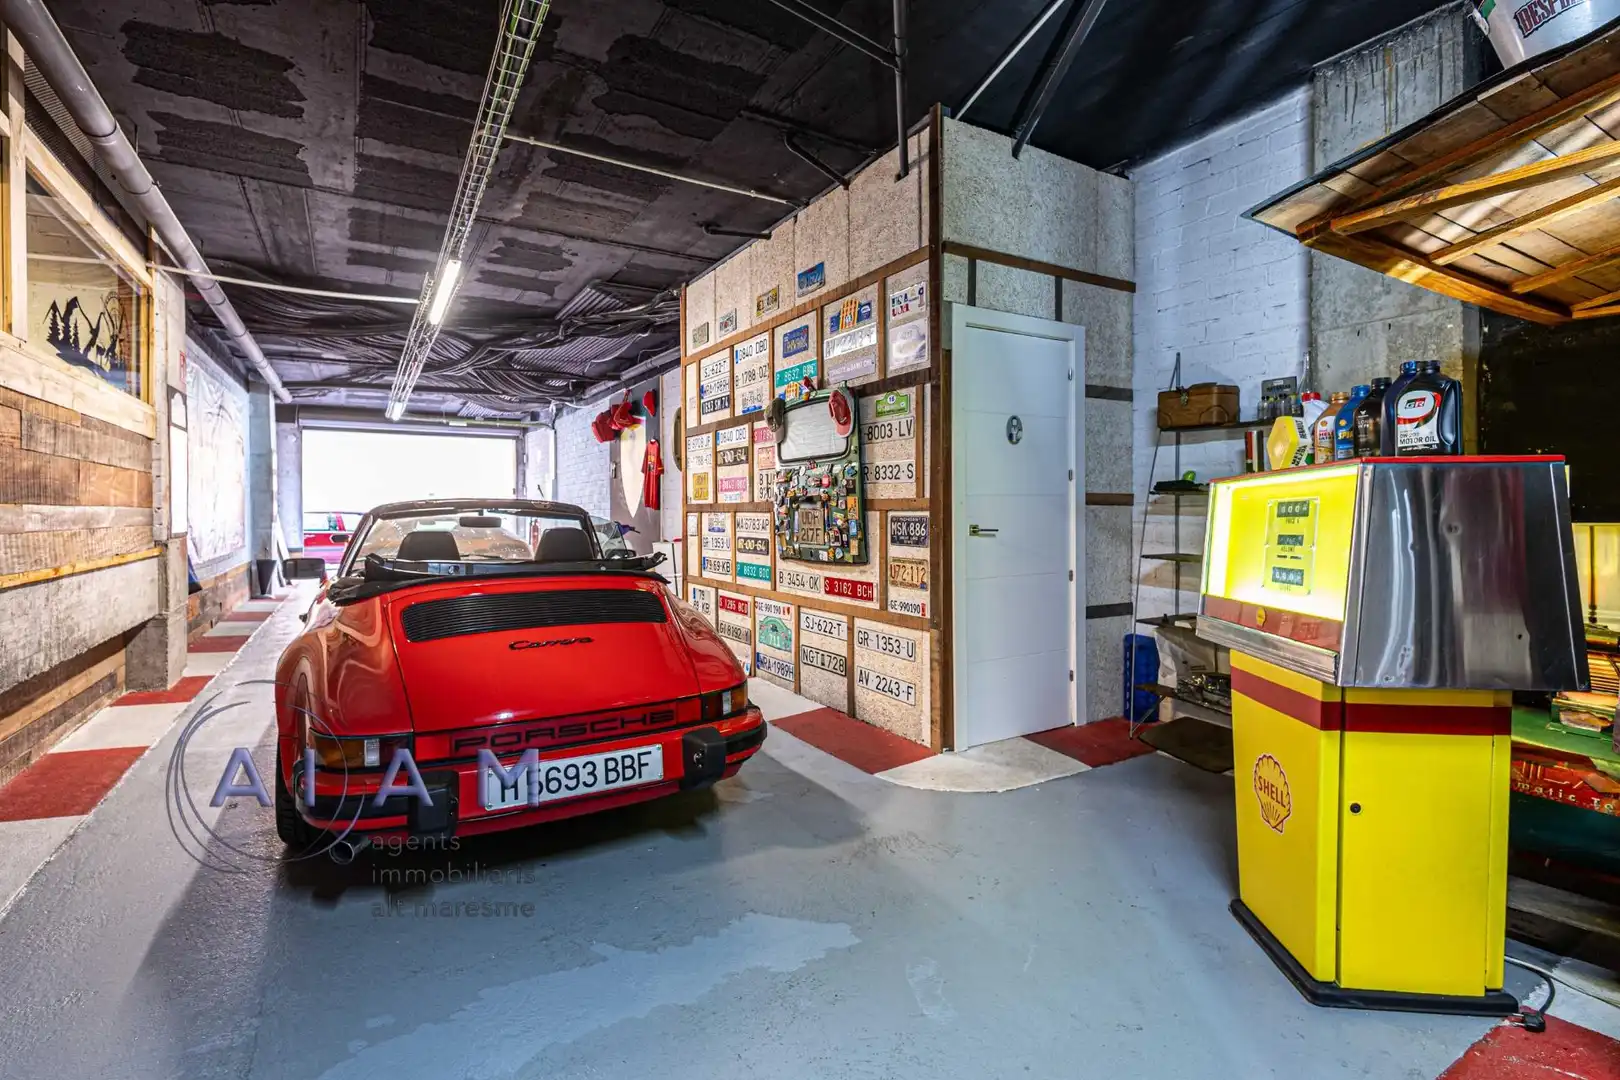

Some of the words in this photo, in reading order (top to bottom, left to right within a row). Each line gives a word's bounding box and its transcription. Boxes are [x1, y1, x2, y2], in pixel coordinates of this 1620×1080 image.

[508, 636, 595, 651] Carrera
[453, 709, 676, 754] PORSCHE
[604, 750, 653, 785] BBF
[1258, 775, 1286, 809] SHELL
